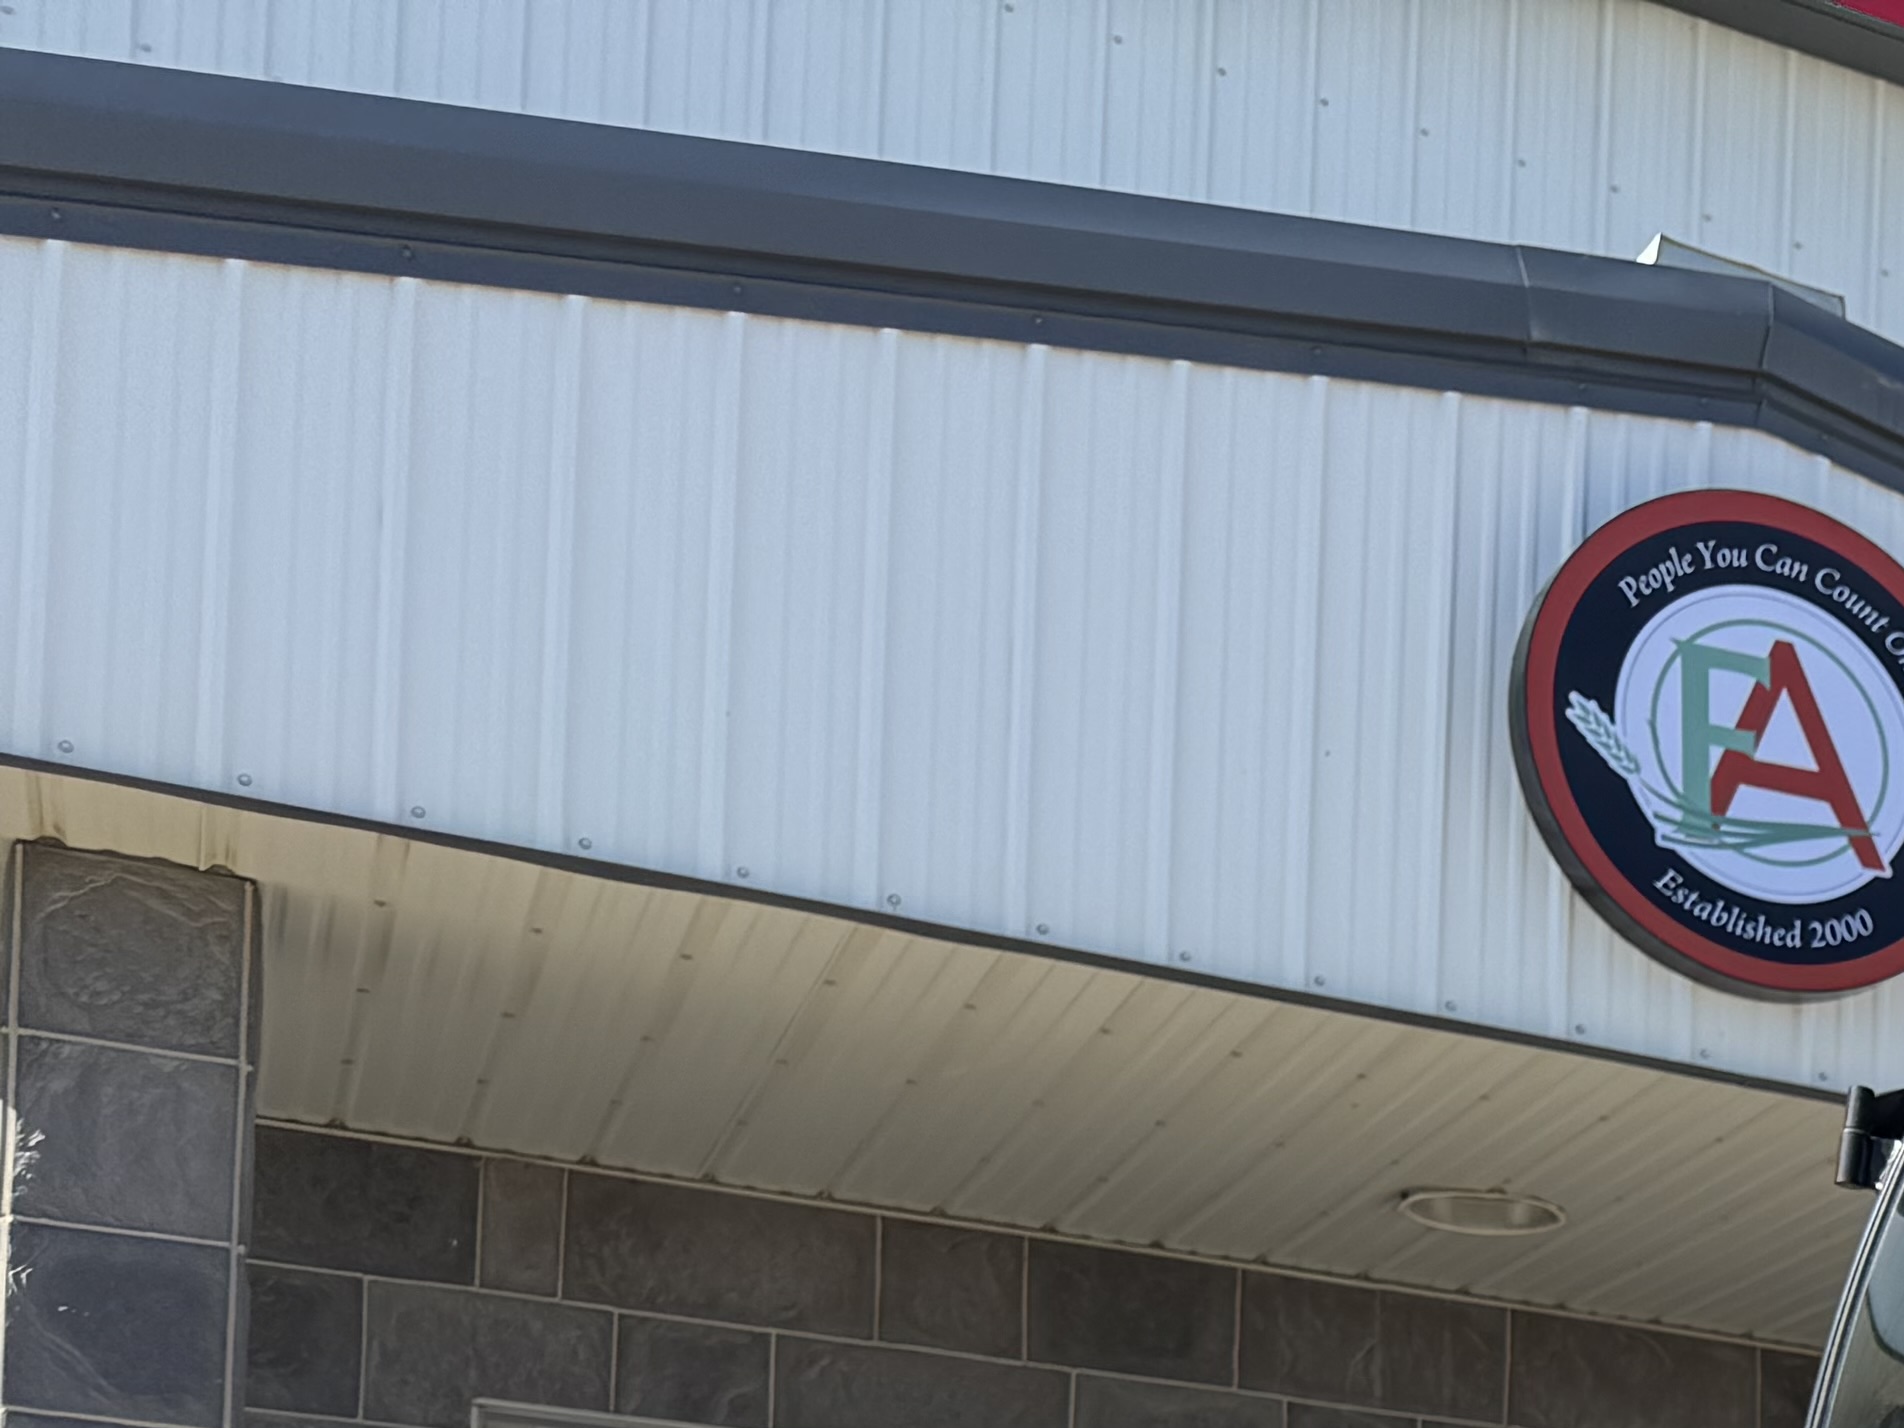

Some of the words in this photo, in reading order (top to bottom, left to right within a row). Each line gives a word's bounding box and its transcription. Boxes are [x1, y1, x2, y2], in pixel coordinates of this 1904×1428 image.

[1617, 546, 1696, 608] People
[1695, 539, 1748, 570] You
[1754, 543, 1809, 582] Can
[1814, 567, 1890, 633] Count
[1652, 867, 1802, 949] Established
[1808, 908, 1874, 949] 2000
